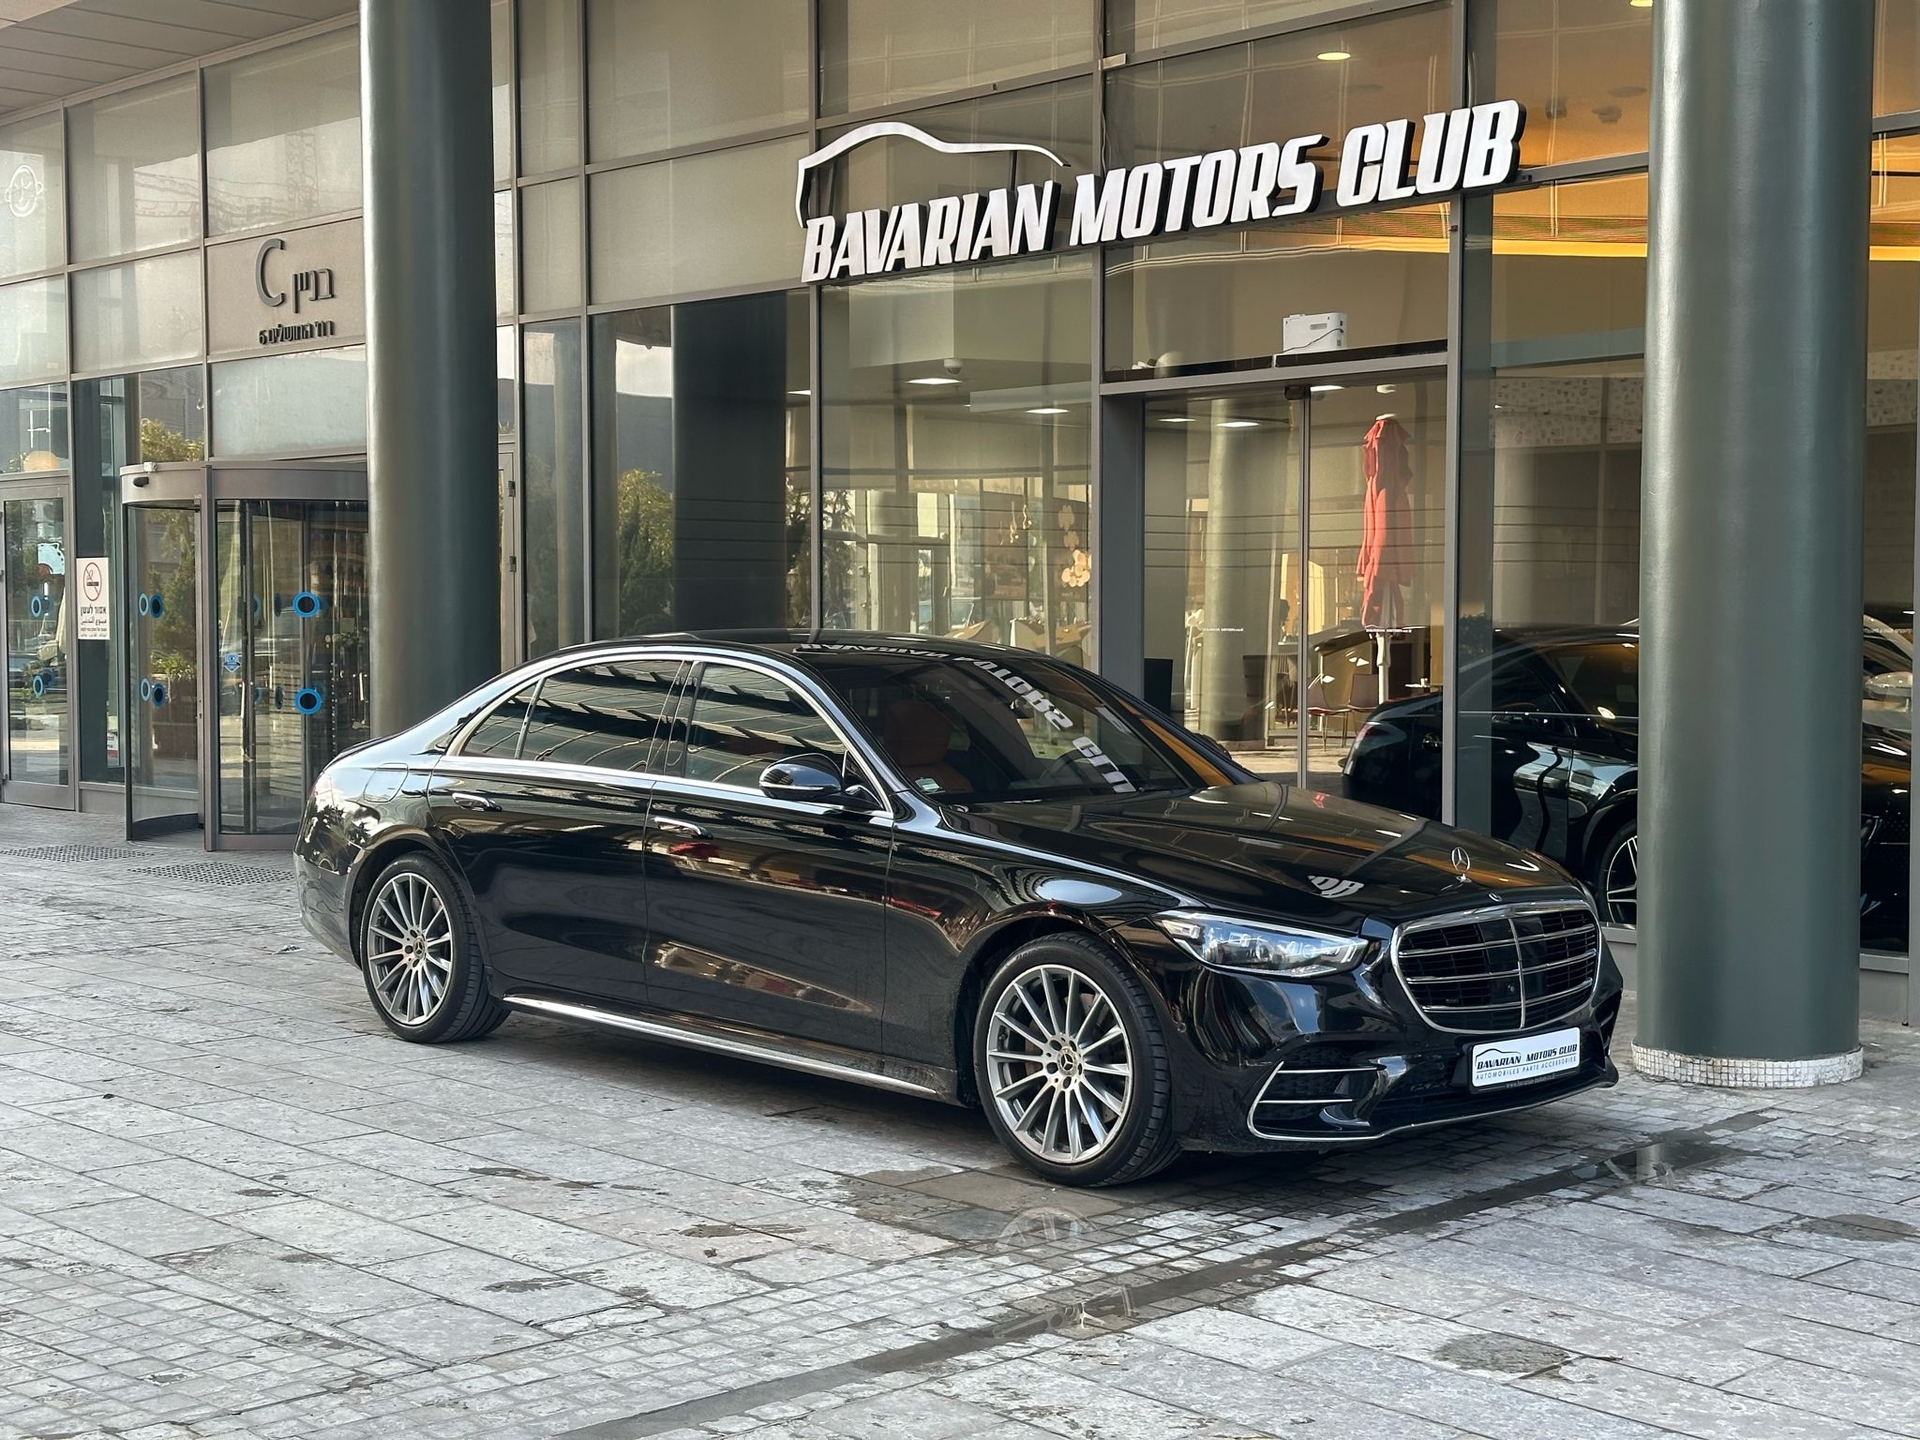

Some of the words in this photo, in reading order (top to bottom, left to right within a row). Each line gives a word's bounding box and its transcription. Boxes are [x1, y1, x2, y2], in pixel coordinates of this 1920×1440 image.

[801, 181, 1058, 283] BAVARIAN
[1069, 134, 1328, 247] MOTORS
[1336, 100, 1523, 207] CLUB
[255, 238, 285, 308] C
[259, 329, 268, 345] 6
[1476, 1055, 1522, 1070] BAVARIAN
[1526, 1047, 1557, 1062] MOTORS
[1559, 1043, 1578, 1055] CLUB
[1476, 1068, 1519, 1080] AUTOMOBILES
[1522, 1064, 1539, 1073] PARTS
[1541, 1056, 1577, 1069] ACCESSORIES
